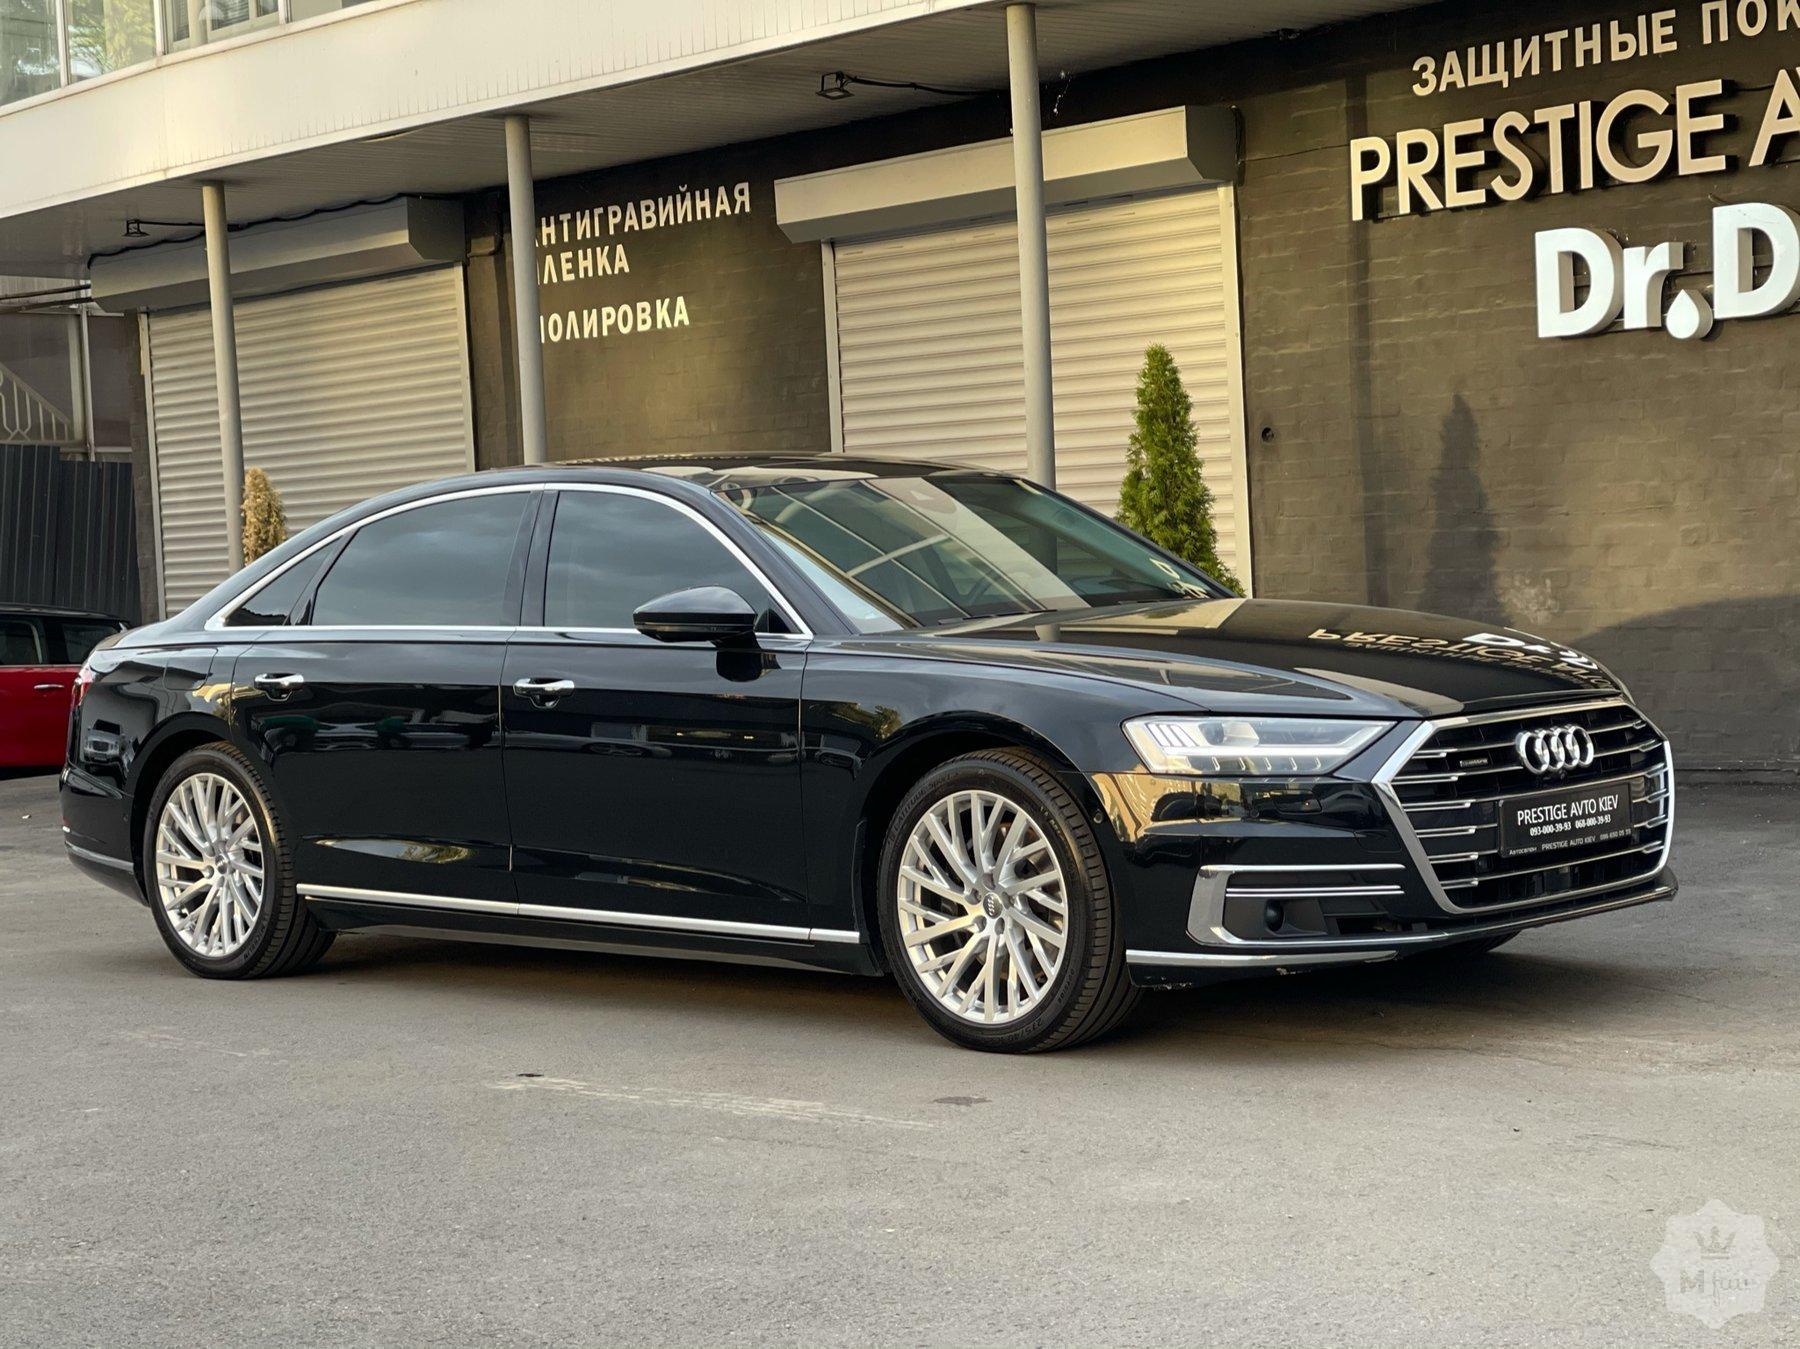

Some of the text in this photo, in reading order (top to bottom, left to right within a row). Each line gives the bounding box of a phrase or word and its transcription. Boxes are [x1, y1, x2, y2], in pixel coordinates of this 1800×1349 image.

[1412, 0, 1800, 96] ЗАЩИТНЫЕ ПОК
[1350, 66, 1800, 221] PRESTIGE A
[535, 182, 751, 247] НТИГРАВИЙНАЯ
[537, 243, 630, 285] ЛЕНКА
[1517, 794, 1619, 826] PRESTIGE AVTO KIEV
[1541, 840, 1569, 850] PRESTIGE
